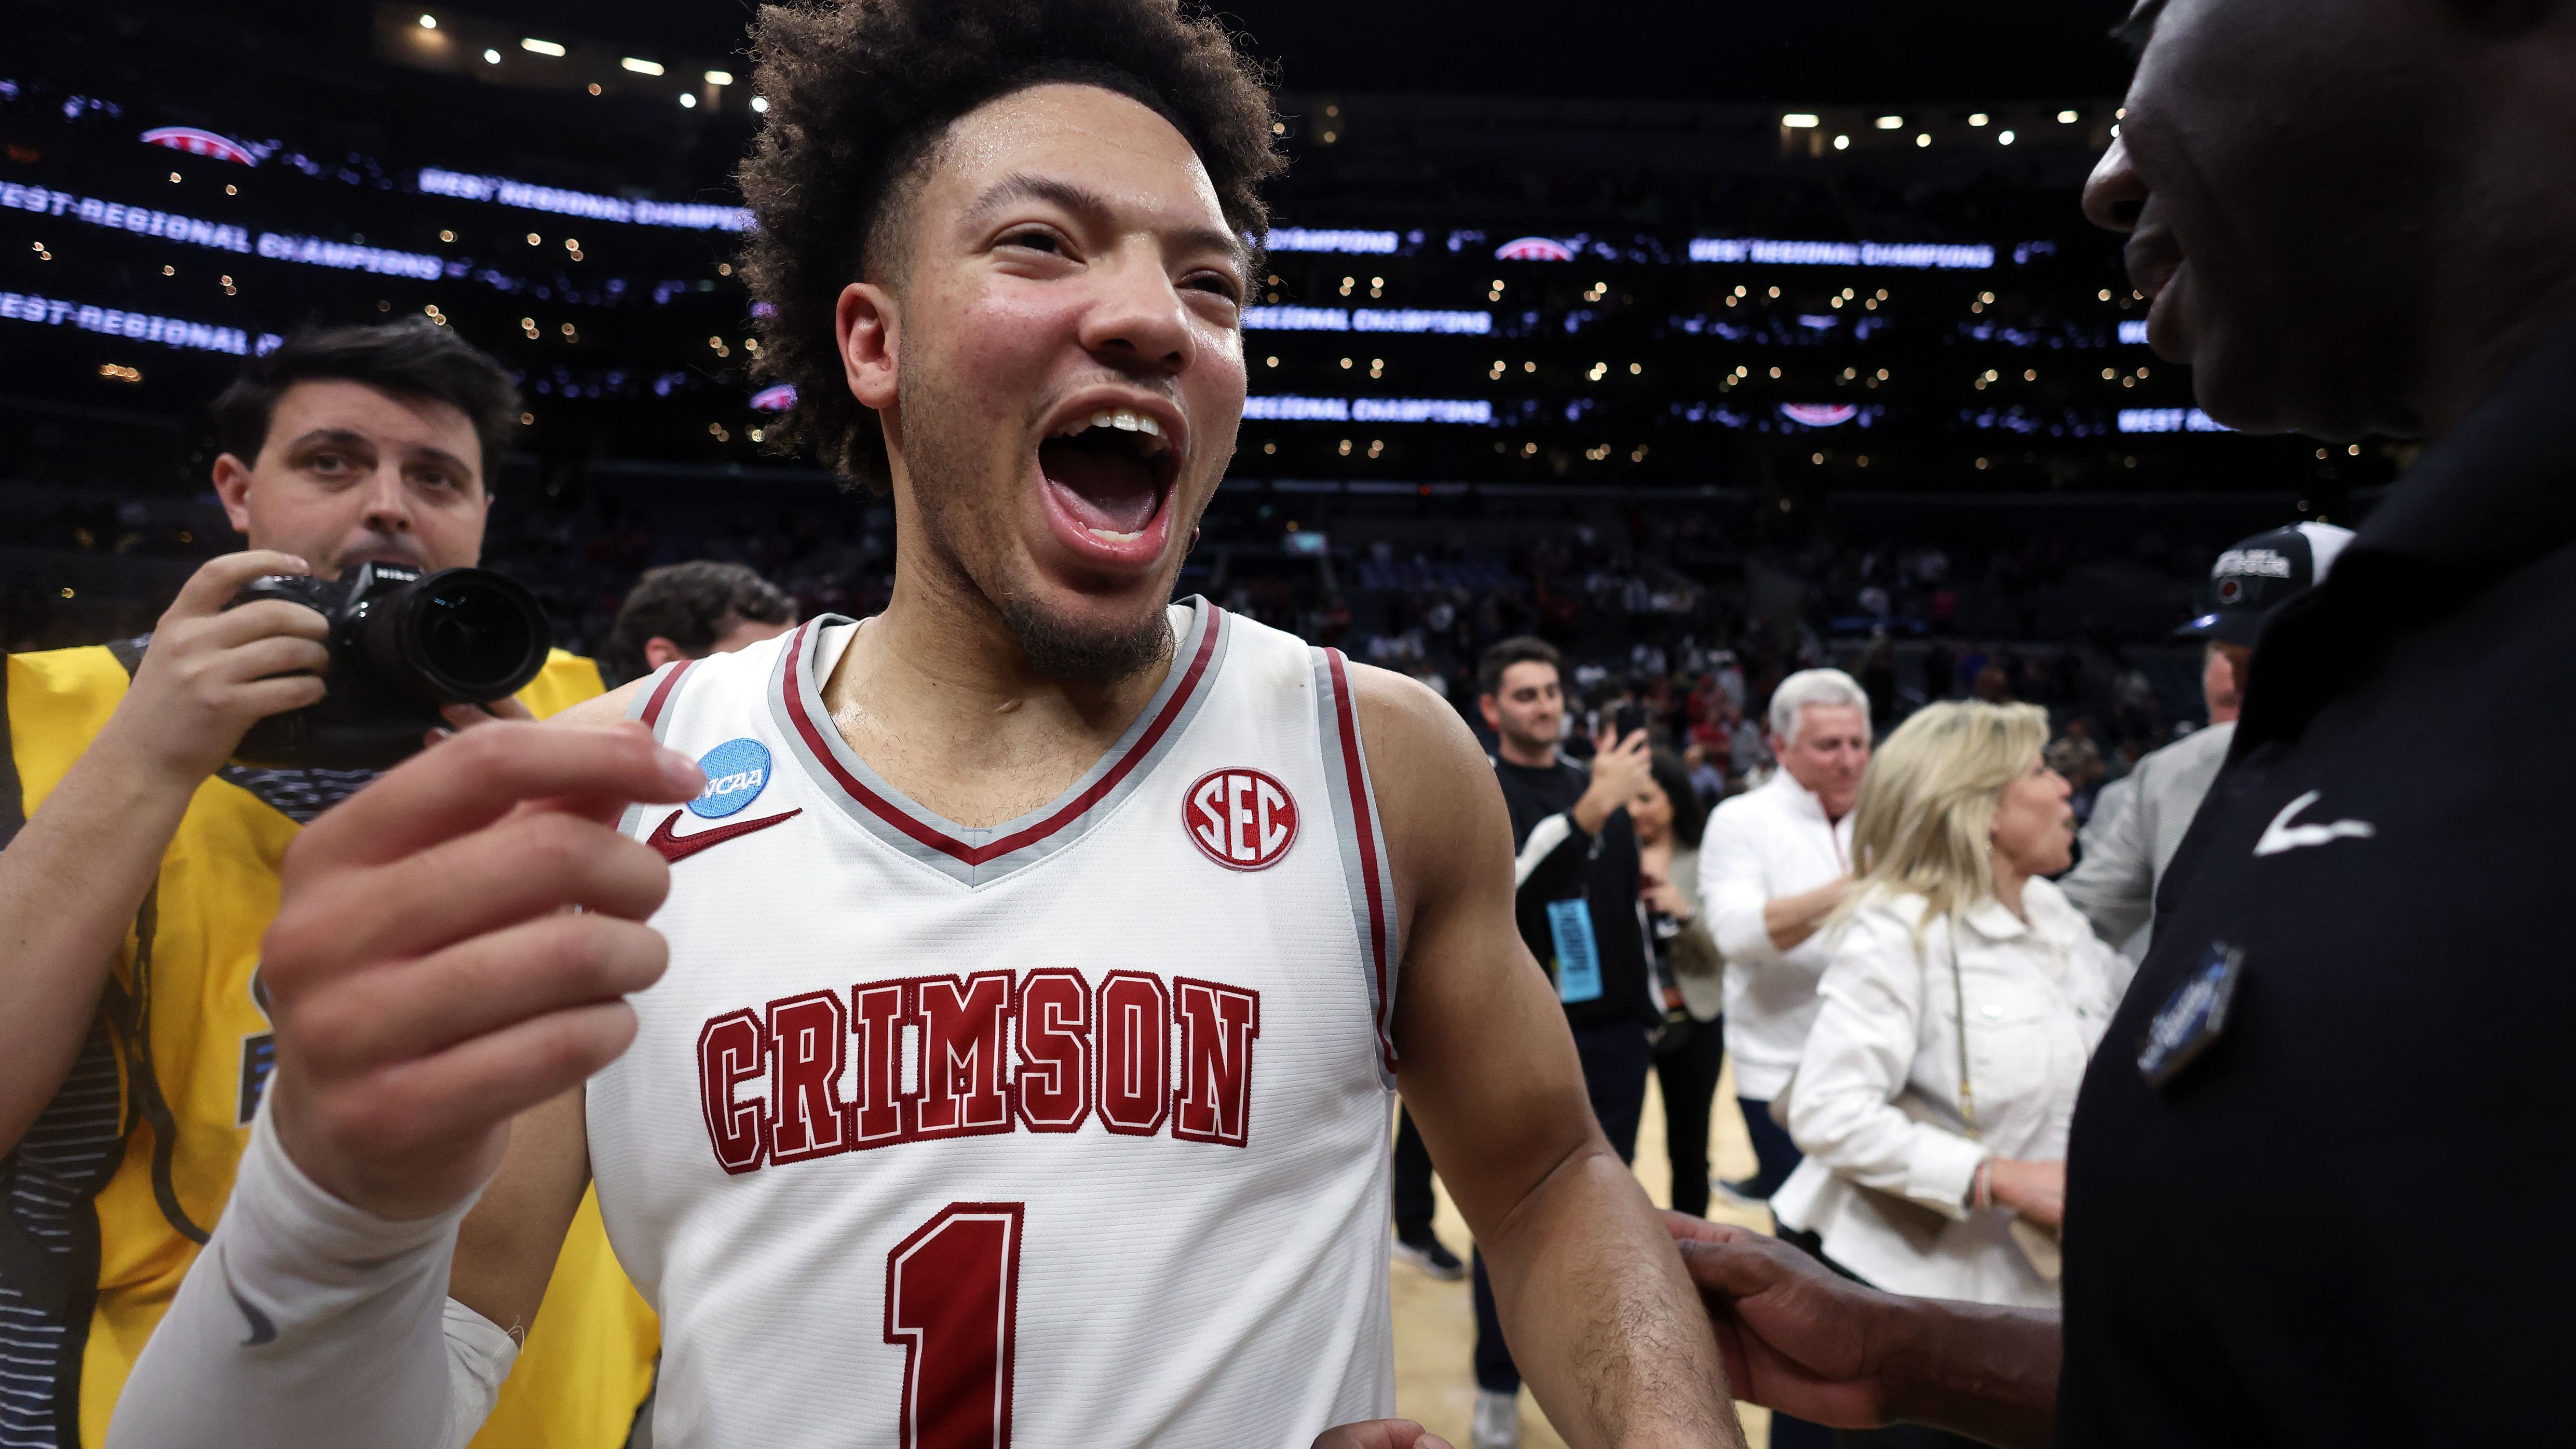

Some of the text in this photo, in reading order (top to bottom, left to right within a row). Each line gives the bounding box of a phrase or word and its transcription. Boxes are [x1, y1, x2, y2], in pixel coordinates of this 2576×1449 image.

[0, 181, 74, 216] EST
[0, 292, 74, 326] EST
[1194, 774, 1288, 861] SEC
[697, 968, 1260, 1175] CRIMSON
[883, 1201, 1025, 1449] 1
